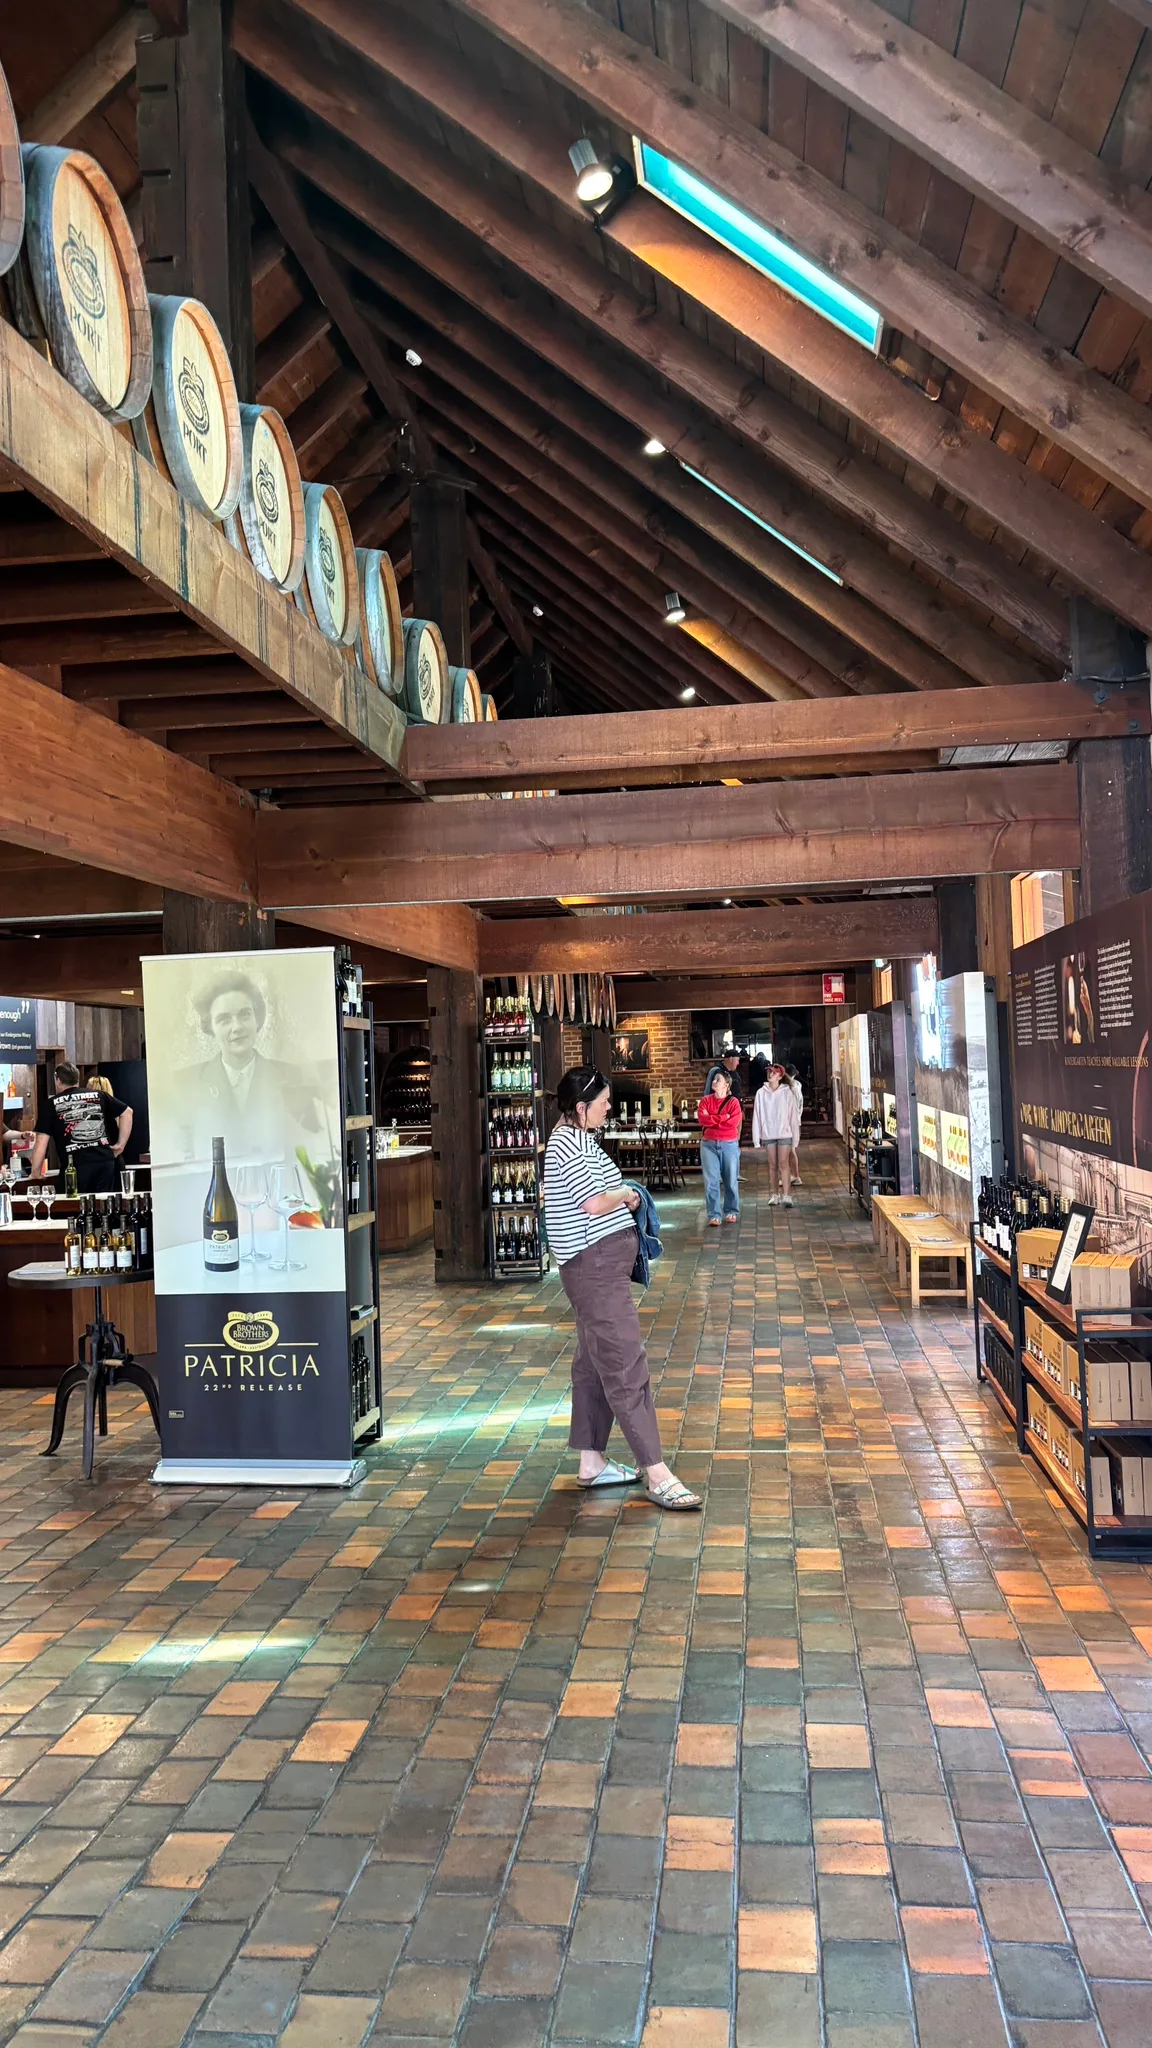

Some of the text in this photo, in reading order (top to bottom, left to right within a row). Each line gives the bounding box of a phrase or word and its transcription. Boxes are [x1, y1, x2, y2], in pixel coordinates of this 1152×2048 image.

[68, 302, 103, 354] PORT
[182, 419, 208, 465] PORT
[1101, 1056, 1112, 1067] SOME
[53, 1094, 70, 1106] KEY
[70, 1091, 99, 1101] STREET
[1020, 1102, 1112, 1146] OUR WINE KINDERGARTEN
[232, 1330, 269, 1339] BROTHERS
[236, 1323, 265, 1332] BROWN
[184, 1354, 320, 1377] PATRICIA
[240, 1383, 303, 1392] RELEASE
